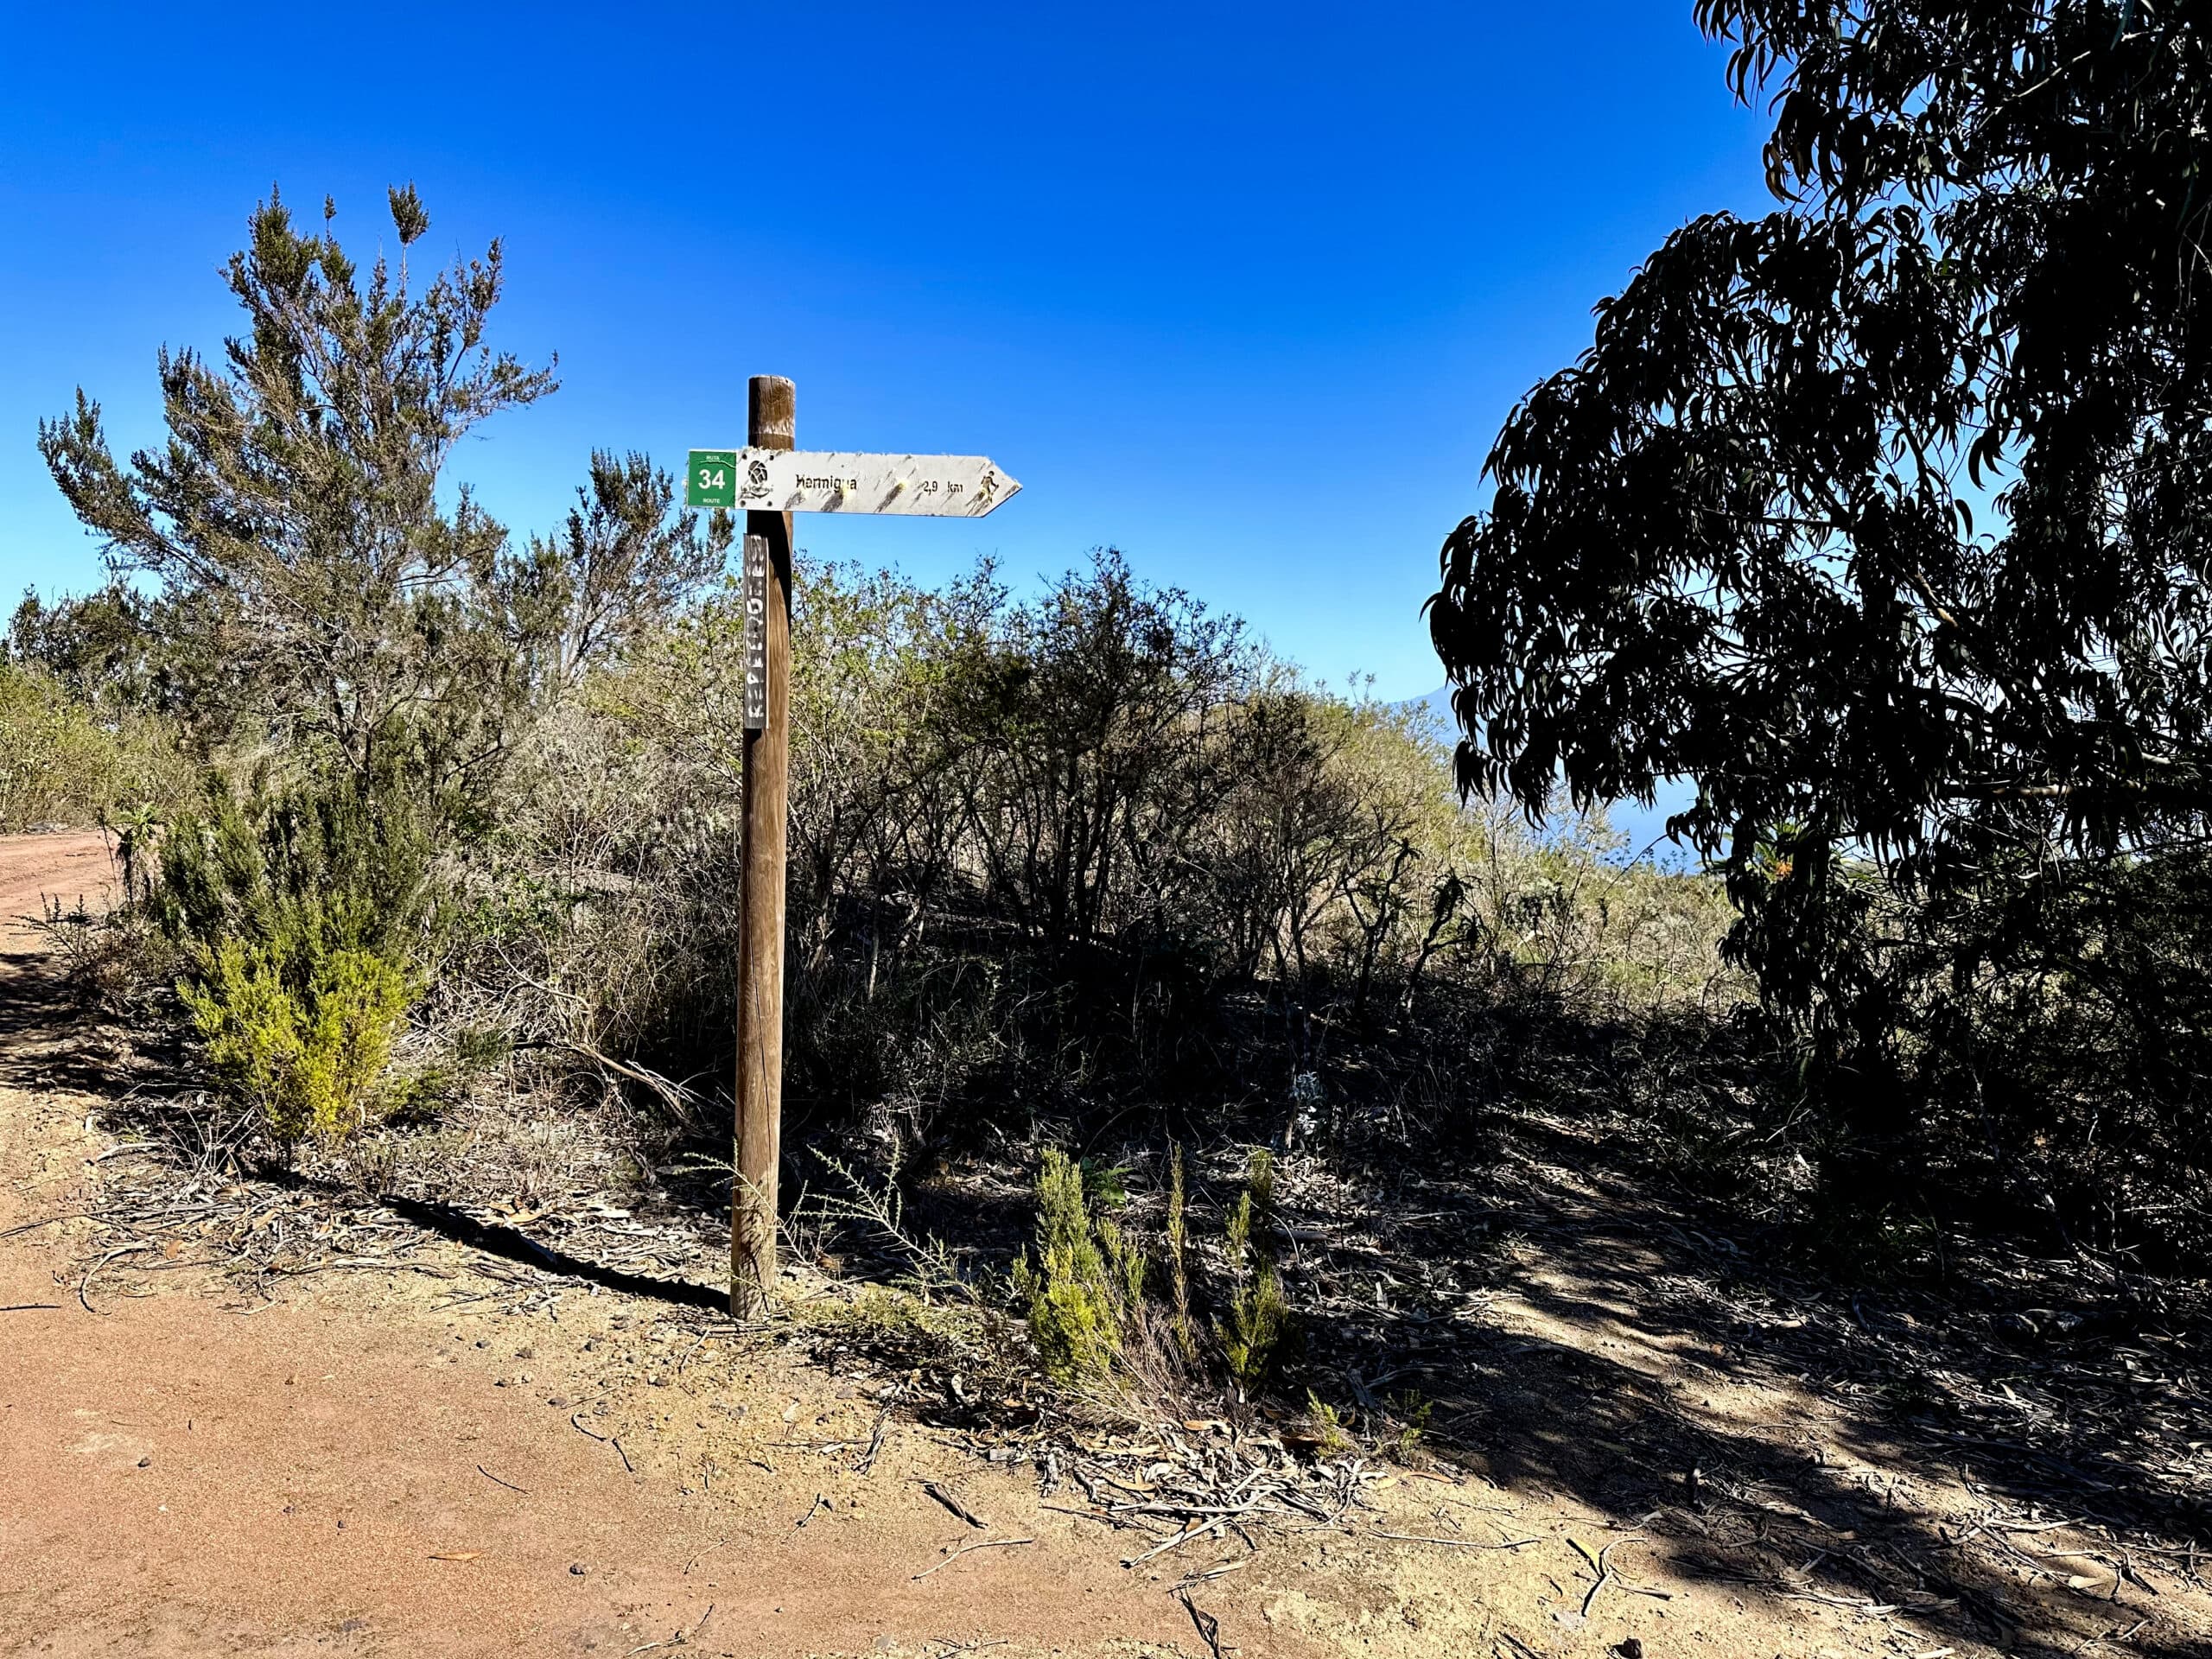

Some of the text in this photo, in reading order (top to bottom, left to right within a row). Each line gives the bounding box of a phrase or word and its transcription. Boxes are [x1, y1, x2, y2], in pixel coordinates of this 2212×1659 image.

[698, 469, 726, 489] 34
[924, 480, 938, 496] 2,9
[947, 480, 963, 493] km
